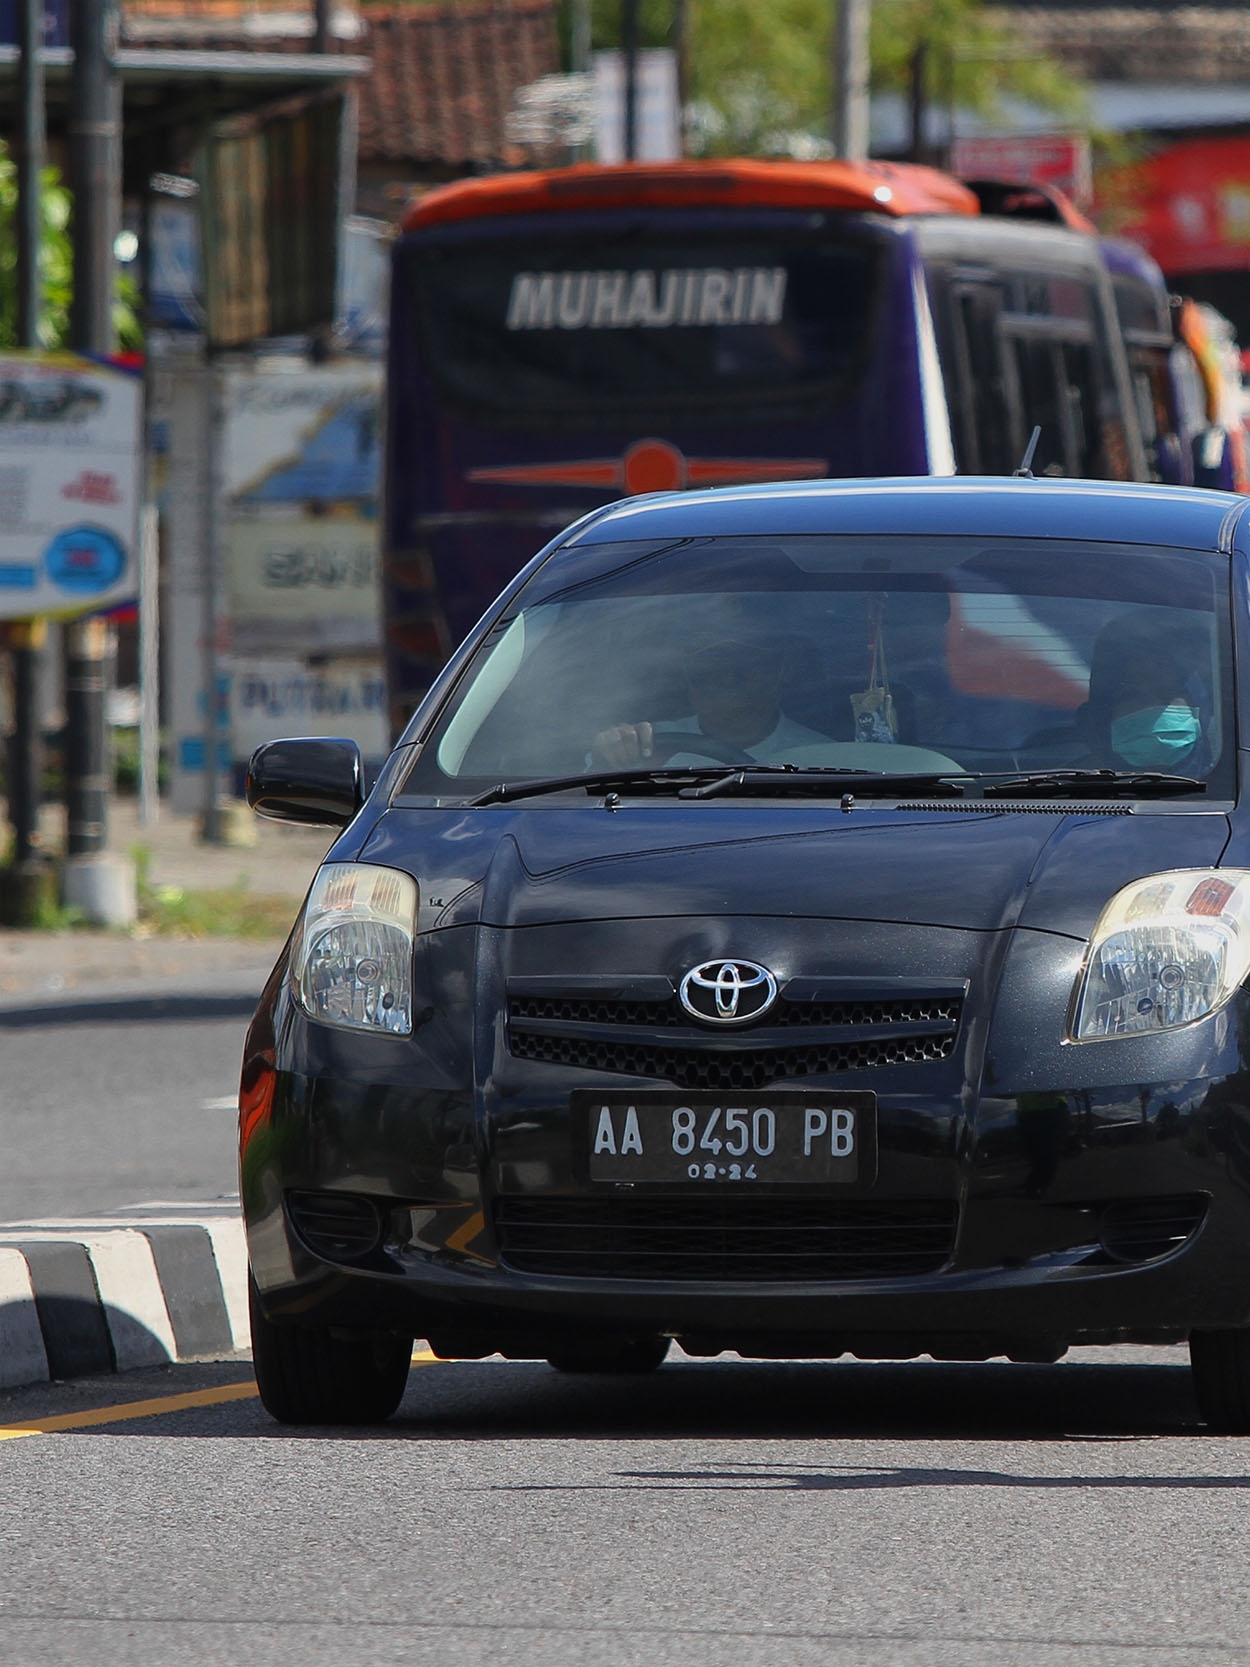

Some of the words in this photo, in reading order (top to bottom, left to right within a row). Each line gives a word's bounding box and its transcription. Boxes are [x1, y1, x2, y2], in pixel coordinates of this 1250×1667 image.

[506, 267, 787, 329] MUHAJIRIN
[593, 1105, 644, 1155] AA
[671, 1106, 776, 1157] 8450
[803, 1107, 855, 1157] PB
